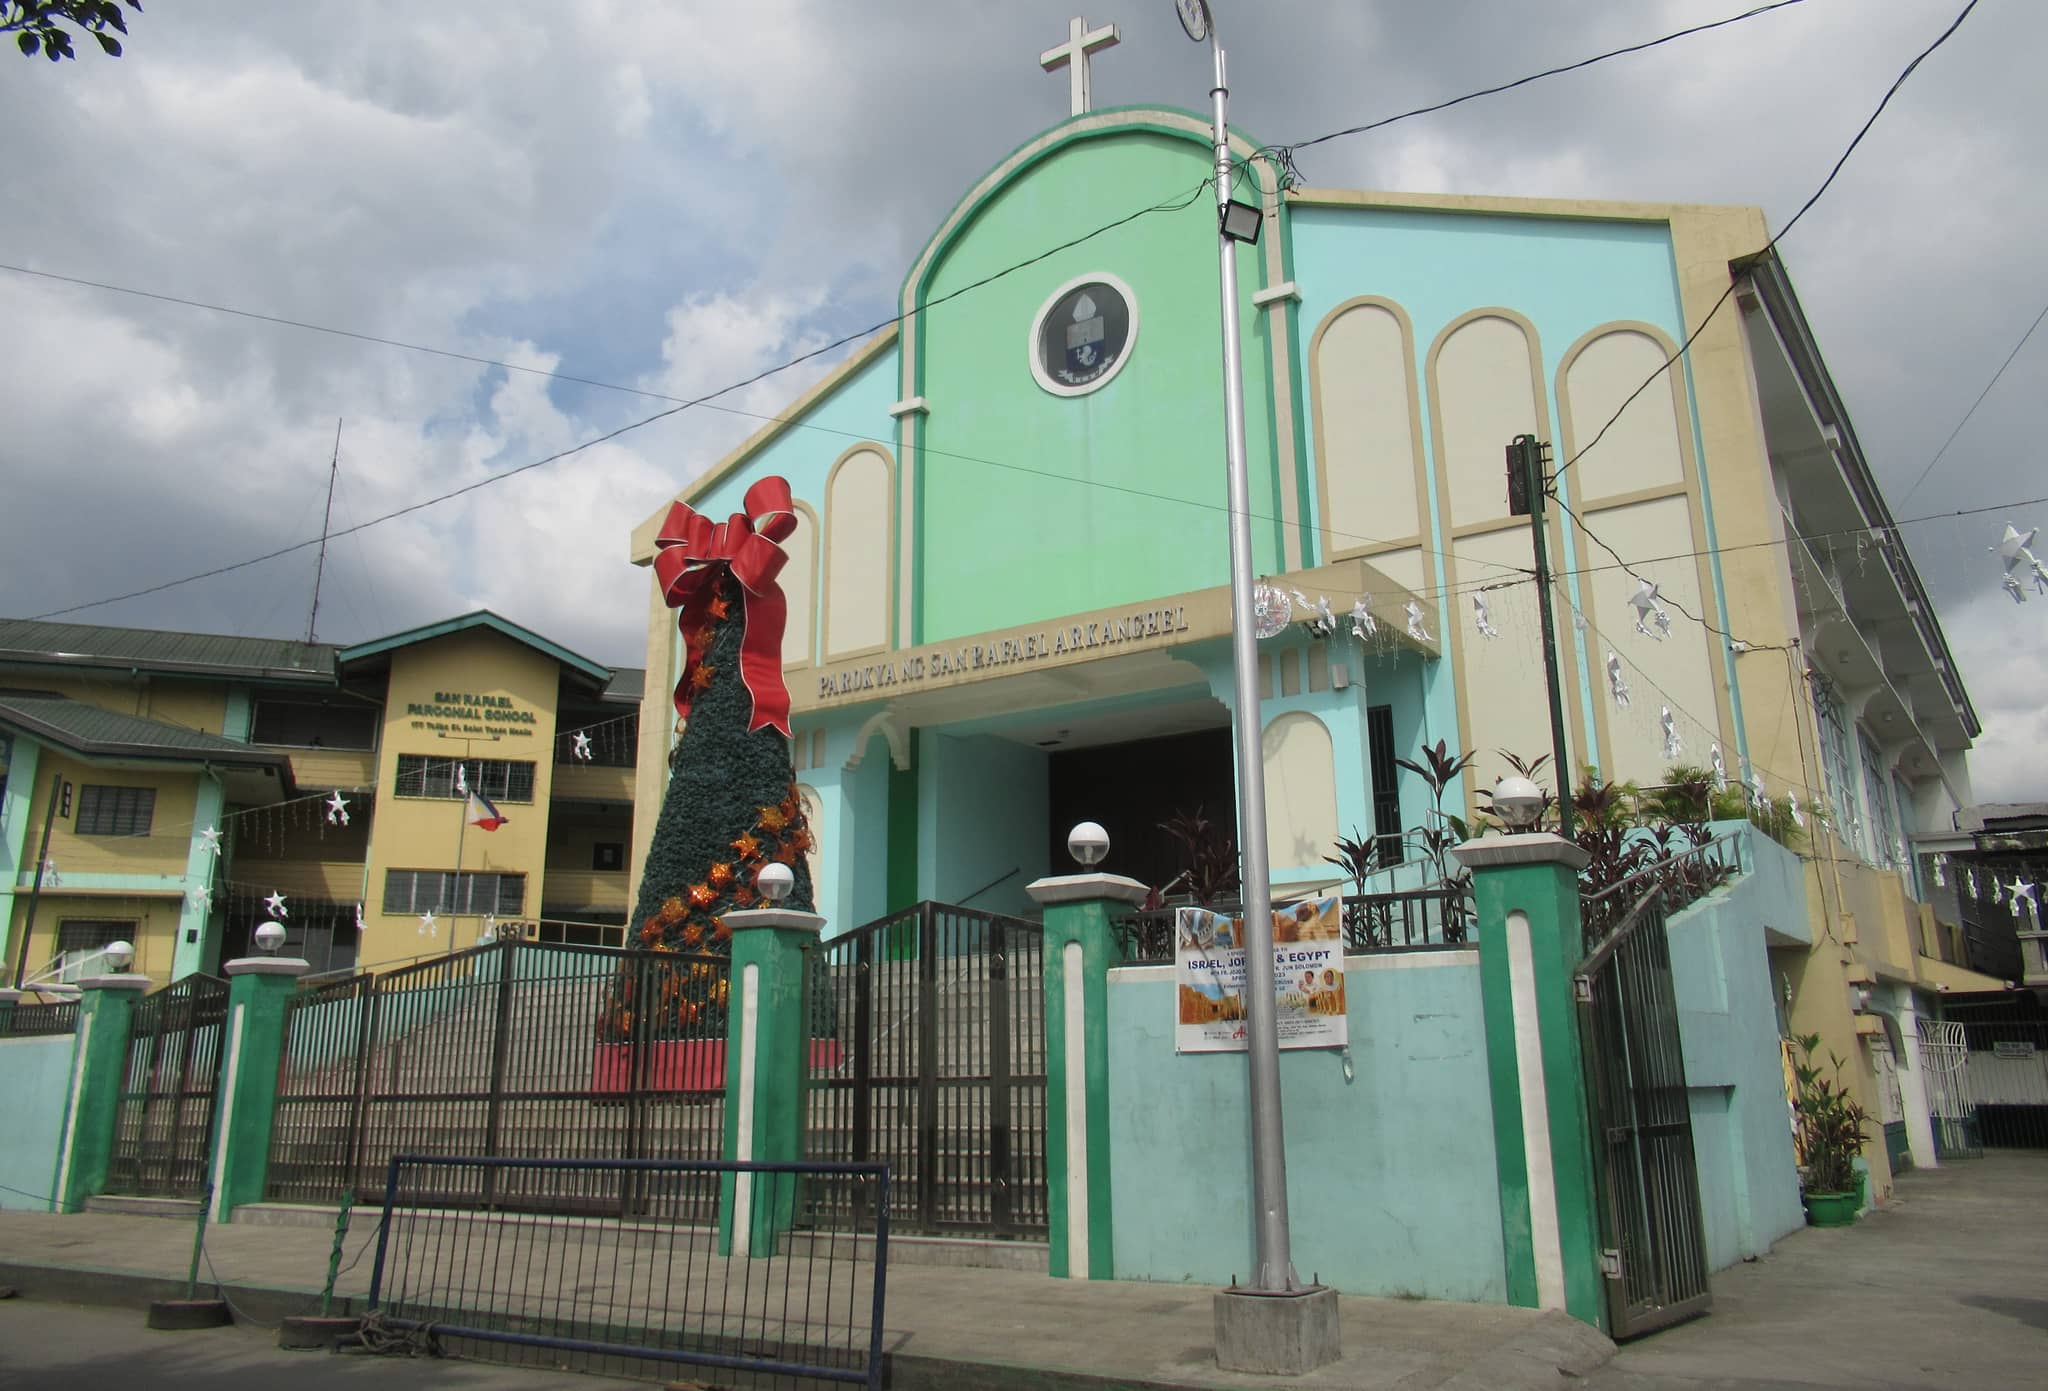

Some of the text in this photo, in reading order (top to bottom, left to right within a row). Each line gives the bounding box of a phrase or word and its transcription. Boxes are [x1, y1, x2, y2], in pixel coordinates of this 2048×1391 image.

[902, 655, 925, 682] NG
[930, 648, 967, 677] SAN
[972, 633, 1049, 668] RAFAEL
[1054, 607, 1189, 654] ARKANGHEL
[434, 692, 513, 709] SAN RAFAEL
[407, 703, 537, 724] PAROCHIAL SCHOOL
[1188, 959, 1225, 969] ISRAEL,
[1276, 953, 1285, 963] &
[1289, 950, 1331, 962] EGYPT
